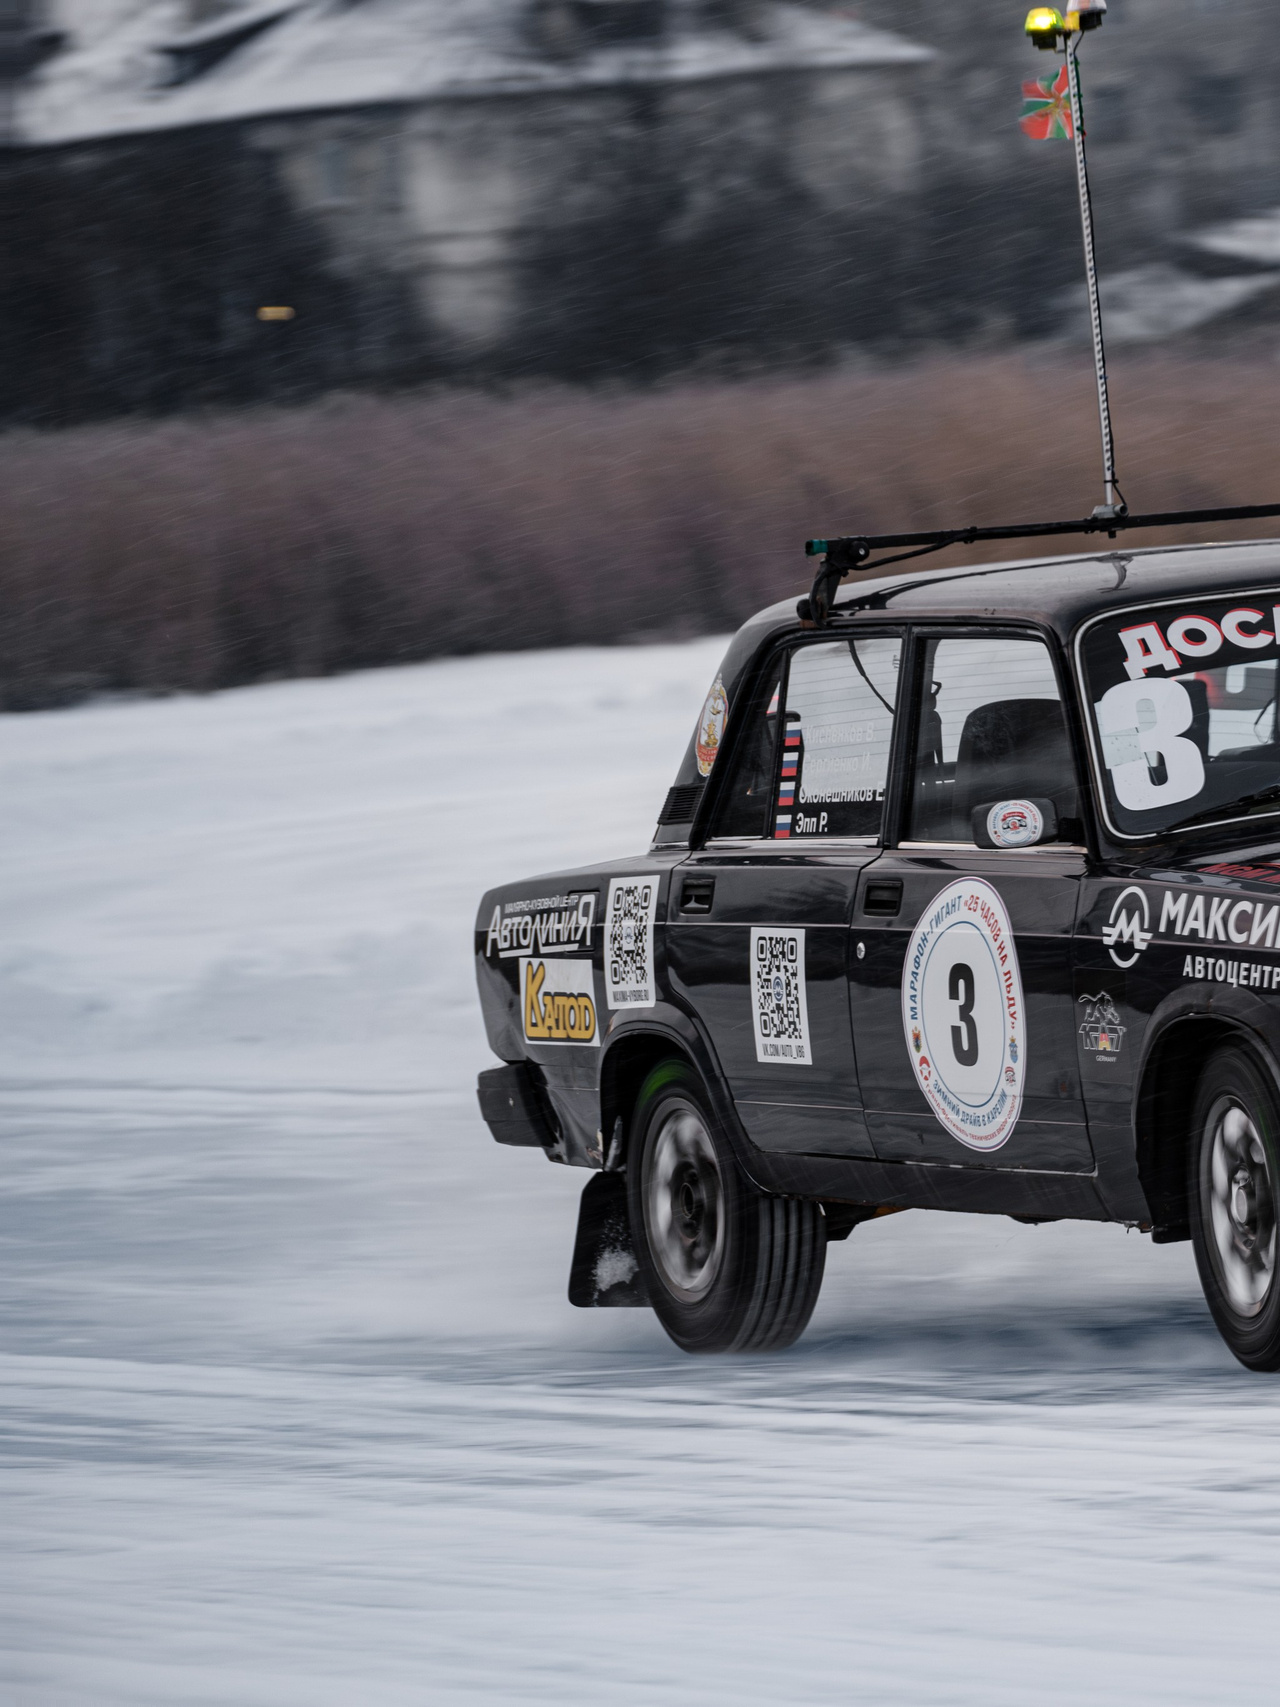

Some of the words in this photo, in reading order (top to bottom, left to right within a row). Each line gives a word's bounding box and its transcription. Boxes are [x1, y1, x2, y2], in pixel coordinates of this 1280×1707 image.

[796, 812, 817, 833] Эпп
[819, 811, 828, 833] Р.
[1197, 862, 1276, 879] MGM
[910, 895, 962, 1020] МАРАФОН-ГИГАНТ
[980, 900, 1002, 942] ЧАСОВ
[997, 940, 1008, 967] НА
[949, 963, 979, 1067] 3
[933, 1079, 960, 1118] ЗИМНИЙ
[960, 1111, 982, 1127] ДРАЙВ
